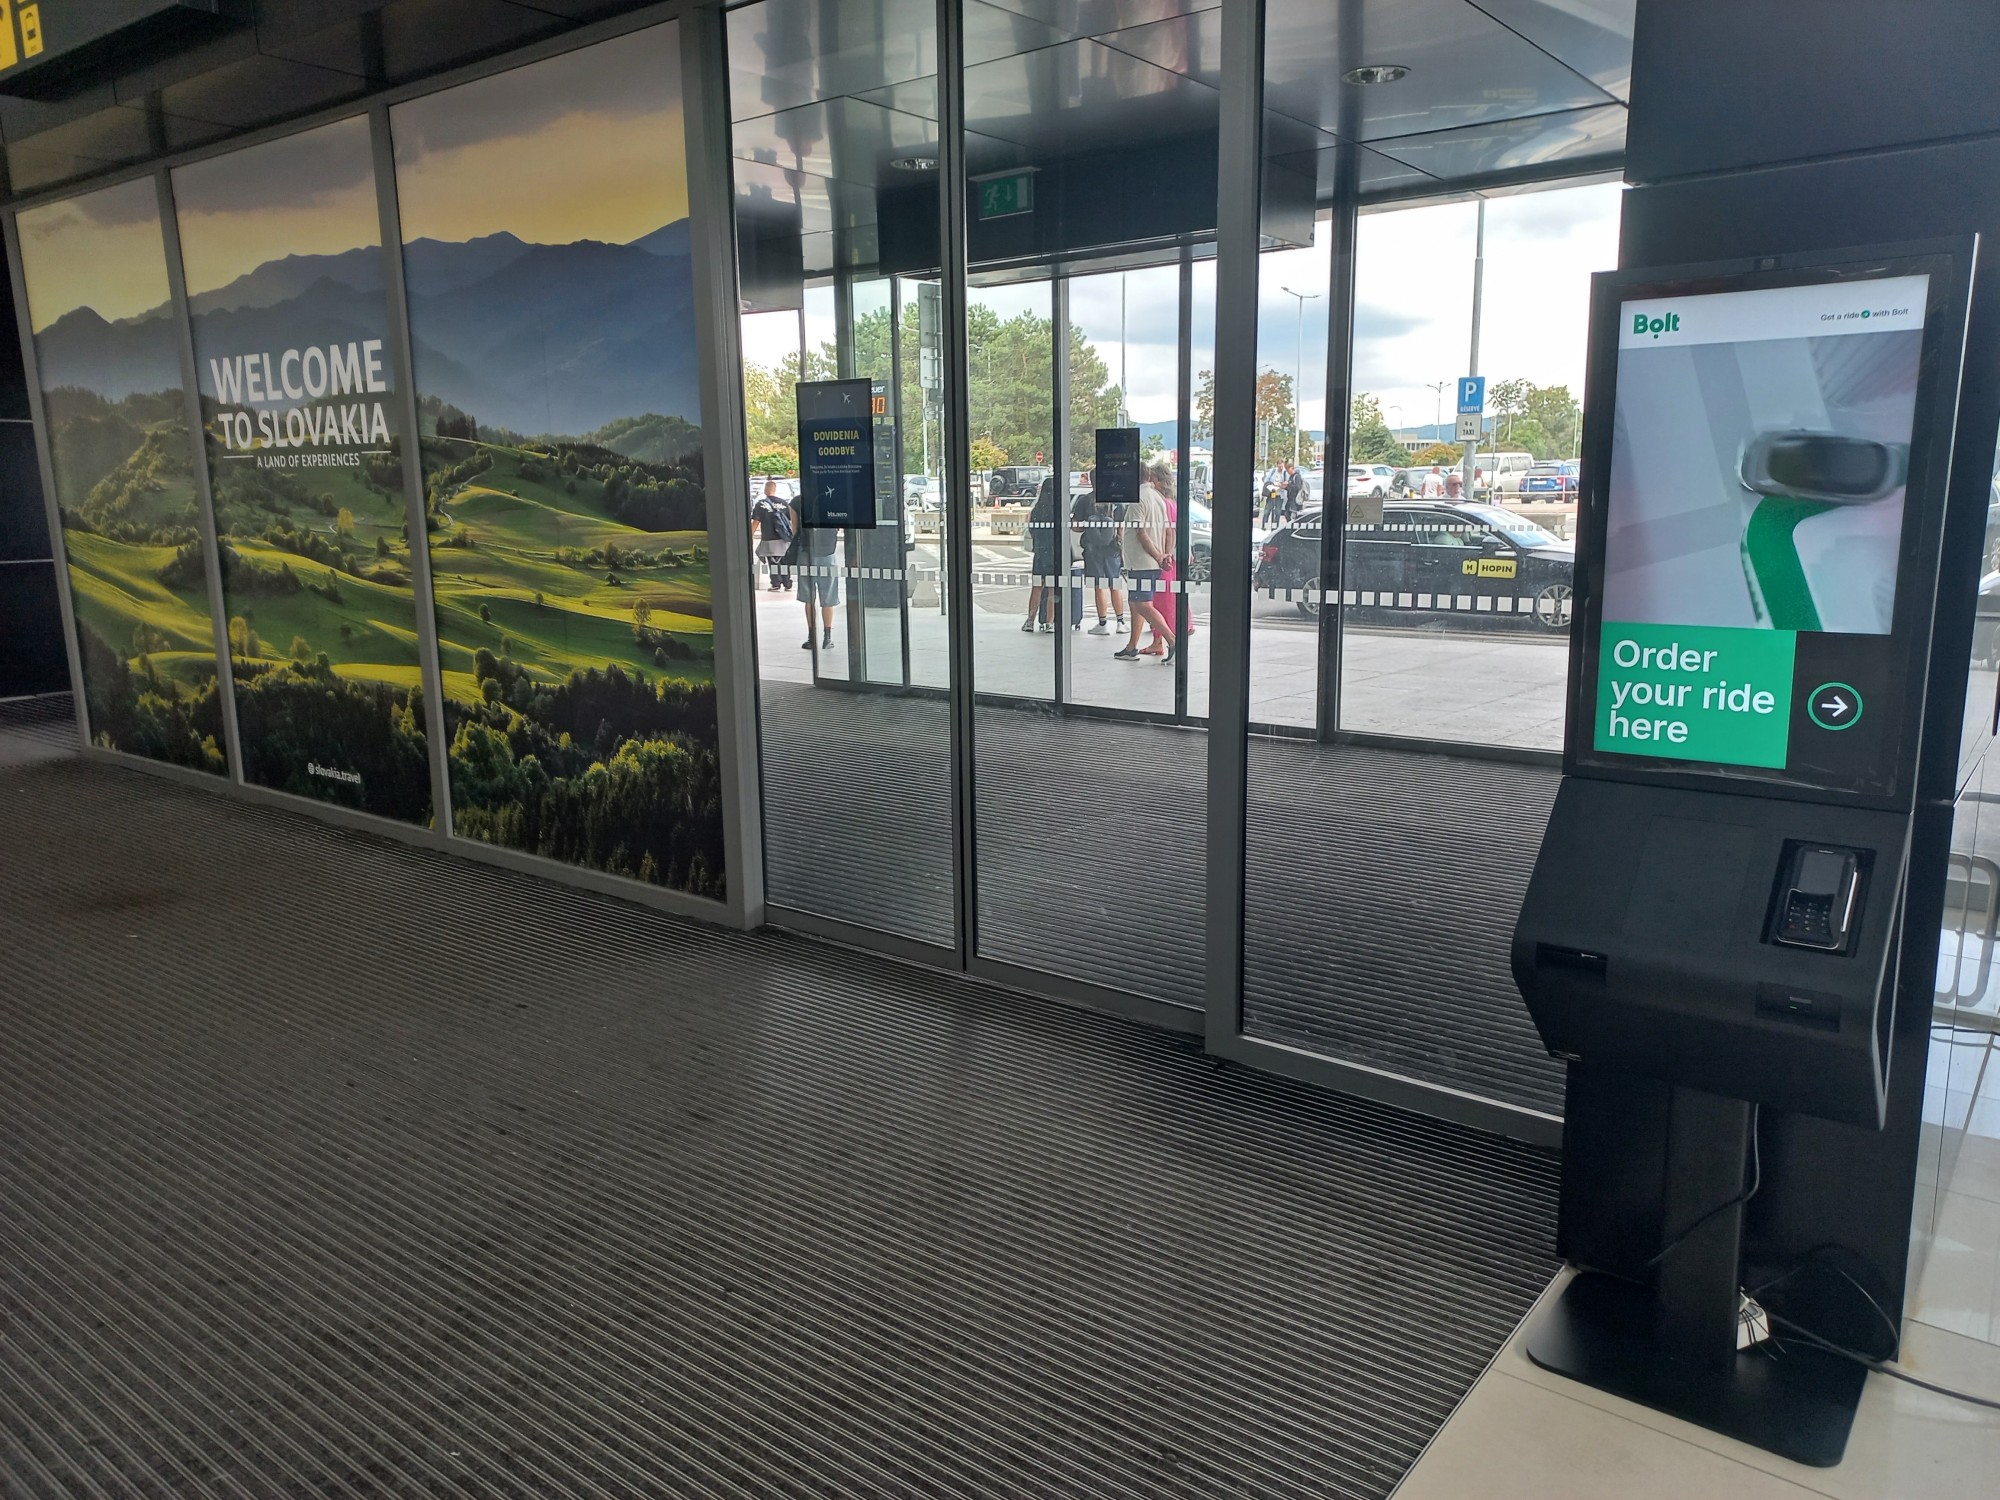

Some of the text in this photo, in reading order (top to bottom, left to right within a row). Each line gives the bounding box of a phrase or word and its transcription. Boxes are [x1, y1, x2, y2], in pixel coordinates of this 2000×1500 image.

[1820, 313, 1835, 321] Get
[1843, 311, 1860, 320] ride
[1872, 309, 1890, 318] with
[1892, 308, 1909, 317] Bolt
[1633, 312, 1680, 339] Bolt
[210, 339, 386, 405] WELCOME
[1465, 381, 1477, 402] P
[218, 402, 391, 449] TO SLOVAKIA
[814, 430, 860, 441] DOVIDENIA
[257, 452, 360, 468] A LAND OF EXPERIENCES
[818, 446, 855, 456] GOODBYE
[1481, 564, 1512, 573] HOPIN
[1613, 639, 1717, 673] Order
[1610, 680, 1775, 714] your ride
[1608, 710, 1689, 743] here
[315, 764, 361, 784] slovakia.travel
